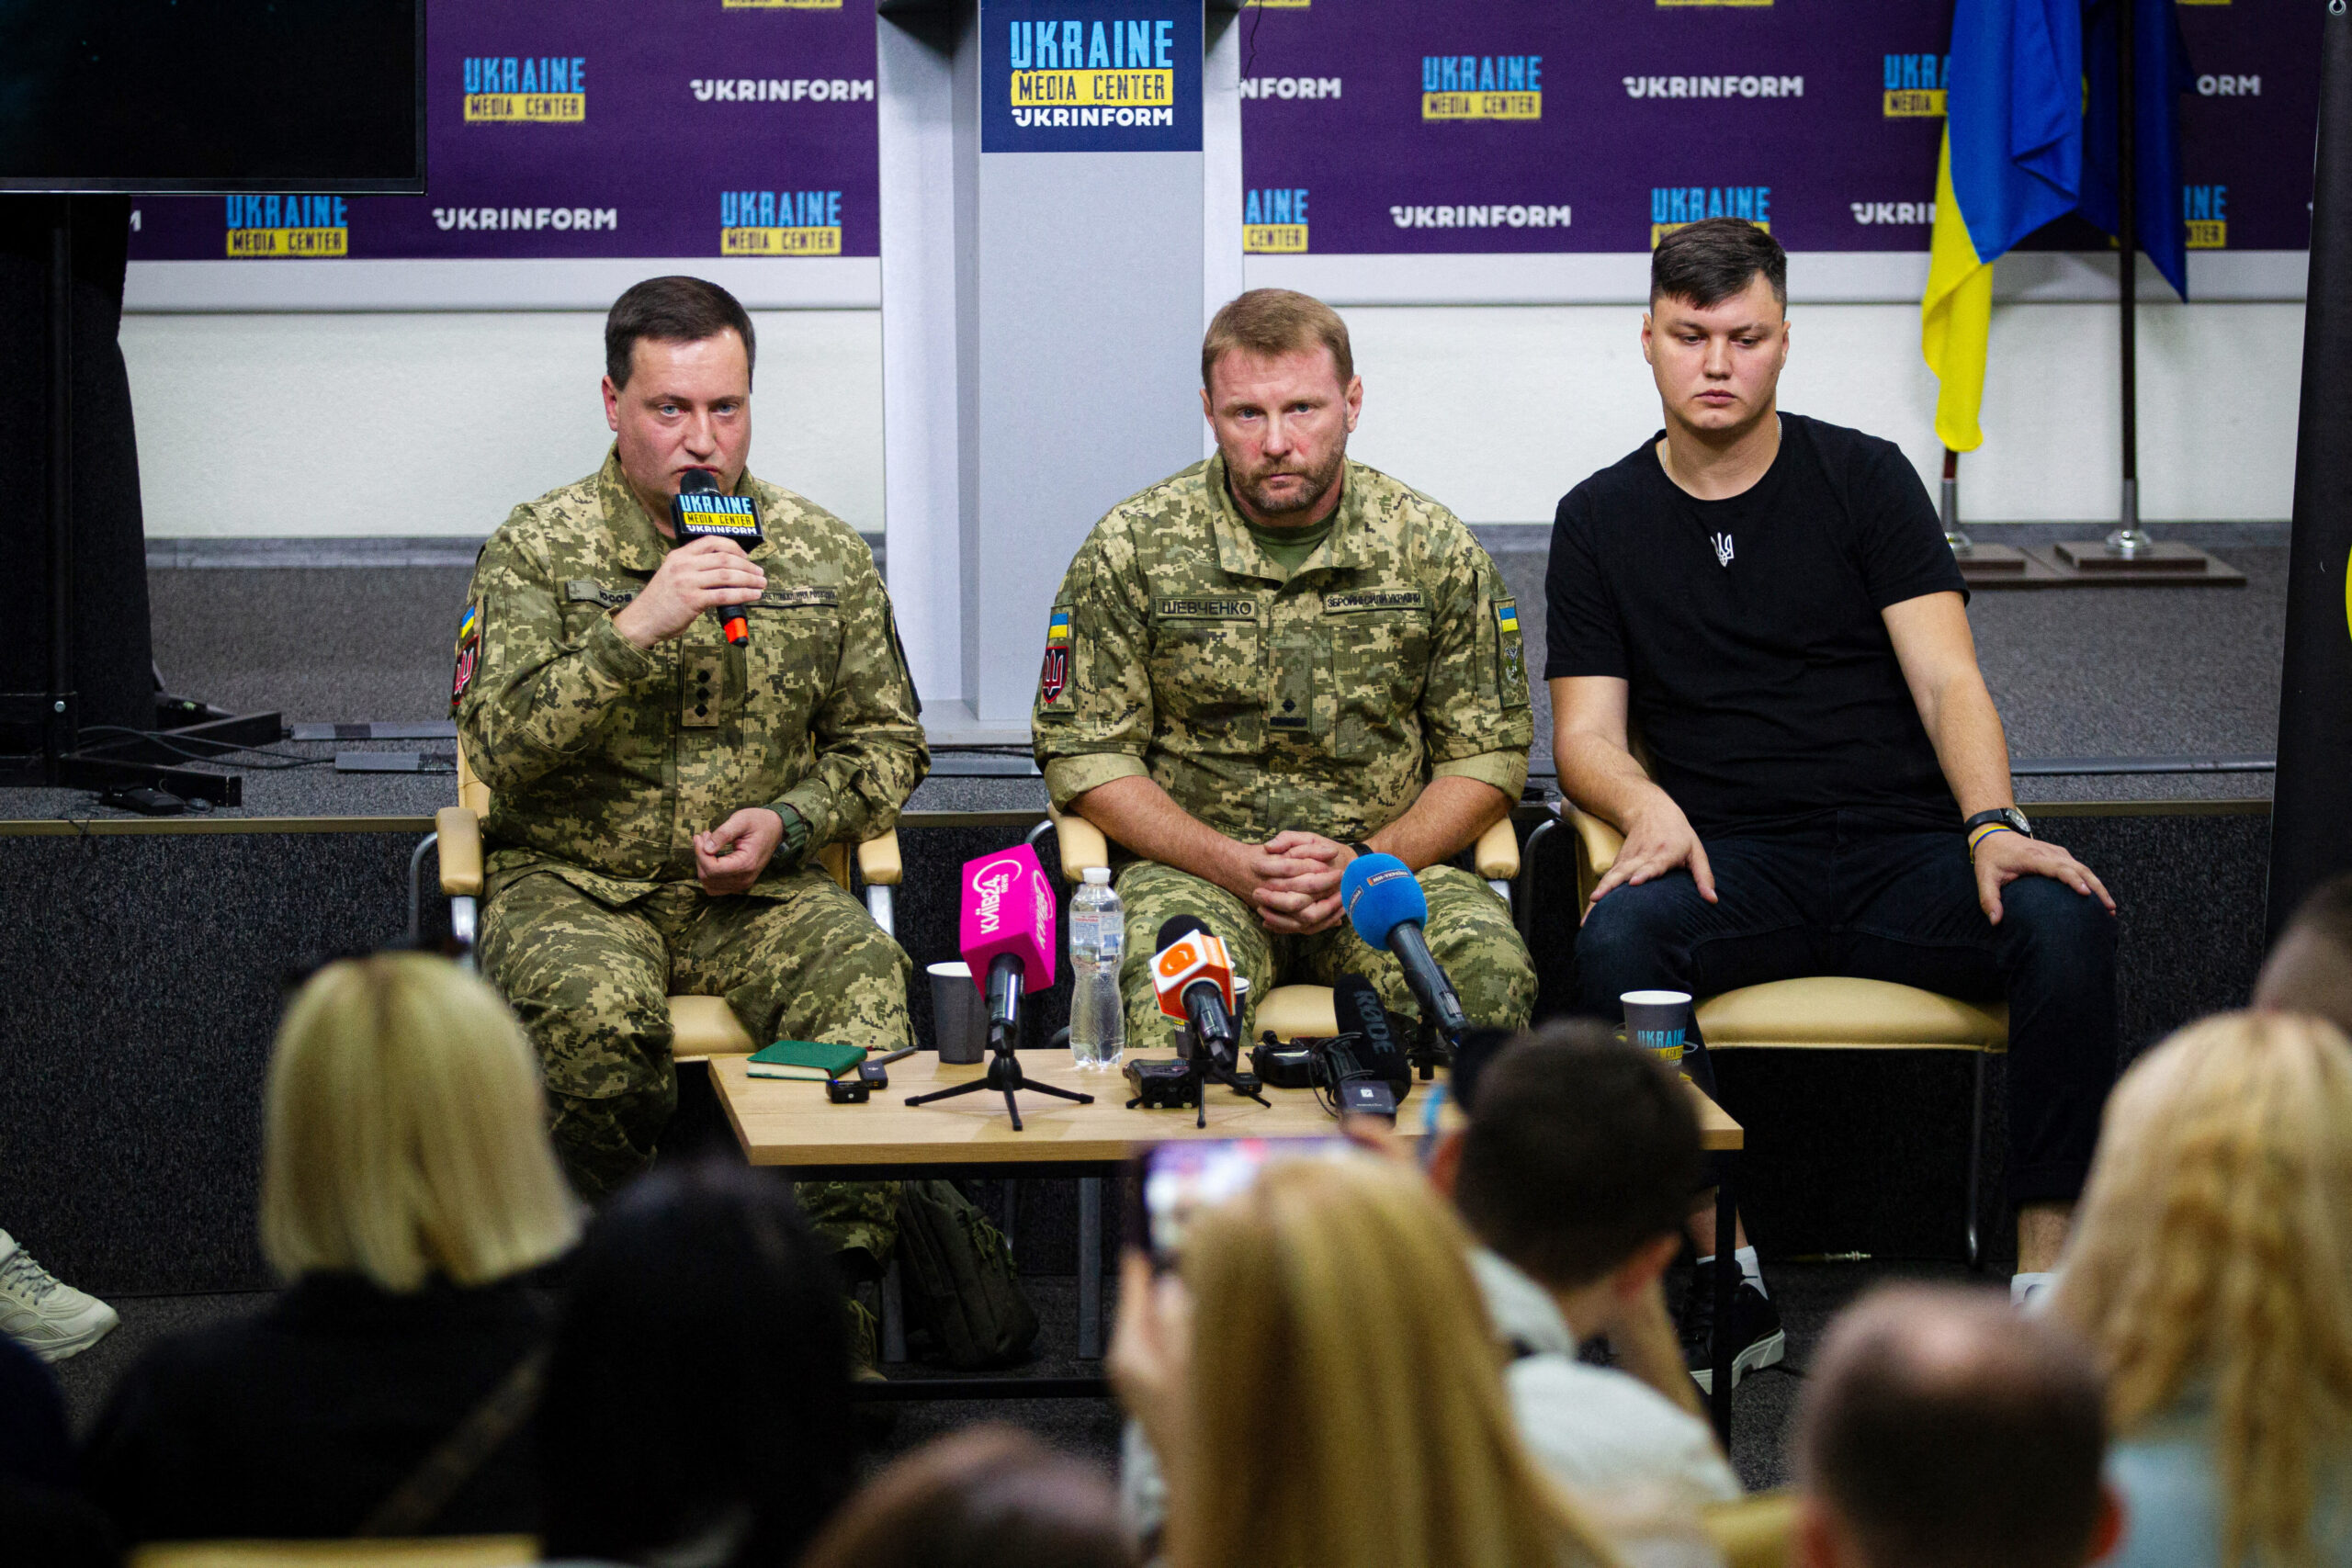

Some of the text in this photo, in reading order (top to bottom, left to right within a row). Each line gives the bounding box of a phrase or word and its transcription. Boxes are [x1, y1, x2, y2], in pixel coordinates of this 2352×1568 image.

[1011, 20, 1173, 69] UKRAINE
[464, 57, 585, 93] UKRAINE
[1422, 55, 1542, 91] UKRAINE
[690, 79, 875, 102] UKRINFORM
[1019, 74, 1165, 101] MEDIA CENTER
[1623, 76, 1804, 97] UKRINFORM
[471, 97, 579, 116] MEDIA CENTER
[1483, 95, 1535, 114] CENTER
[1012, 108, 1173, 127] UKRINFORM
[227, 196, 347, 228] UKRAINE
[721, 191, 842, 227] UKRAINE
[1651, 186, 1770, 222] UKRAINE
[434, 209, 617, 231] UKRINFORM
[1390, 205, 1571, 227] UKRINFORM
[233, 231, 342, 251] MEDIA CENTER
[728, 231, 835, 250] MEDIA CENTER
[679, 494, 752, 514] UKRAINE
[687, 513, 752, 525] MEDIA CENTER
[685, 525, 757, 535] UKRINFORM
[1161, 601, 1252, 615] ШЕВЧЕНКО
